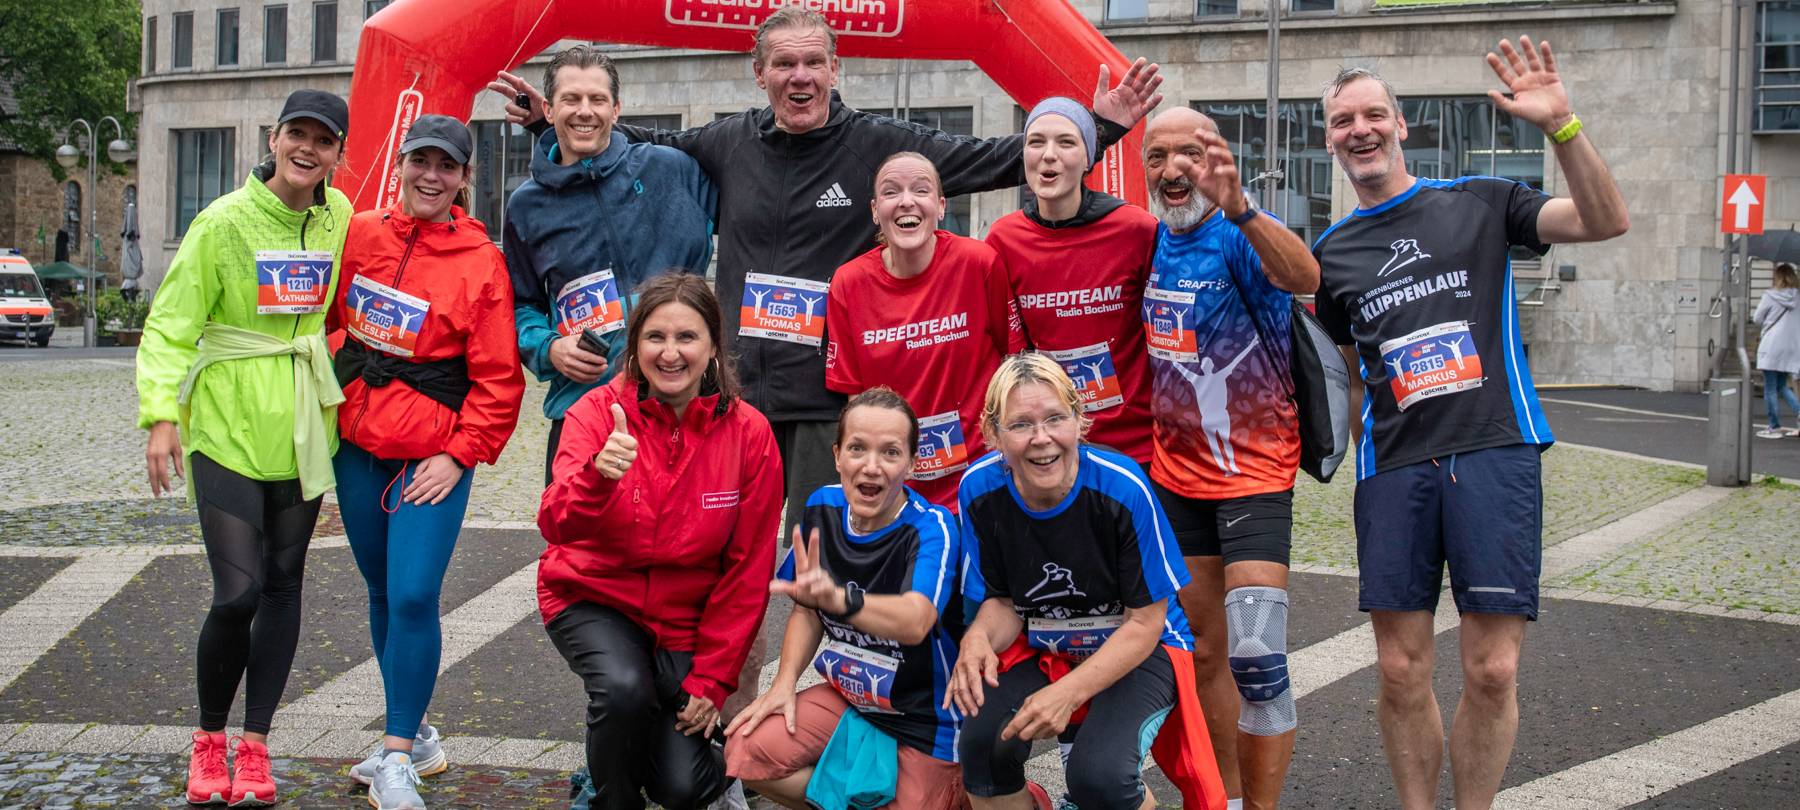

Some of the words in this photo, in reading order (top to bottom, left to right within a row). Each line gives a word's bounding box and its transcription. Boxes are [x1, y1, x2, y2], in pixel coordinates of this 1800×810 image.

[816, 197, 852, 207] adidas
[288, 279, 313, 290] 1210
[1177, 279, 1216, 289] CRAFT
[1365, 275, 1414, 299] IBBENBÜRENER
[278, 294, 319, 302] KATHARINA
[1019, 285, 1122, 309] SPEEDTEAM
[1360, 270, 1468, 323] KLIPPENLAUF
[1455, 290, 1472, 298] 2024
[575, 306, 587, 320] 23
[768, 304, 796, 318] 1563
[1056, 307, 1082, 317] Radio
[1084, 302, 1123, 315] Bochum
[366, 311, 392, 329] 2505
[568, 314, 605, 335] ANDREAS
[759, 317, 801, 332] THOMAS
[863, 312, 967, 345] SPEEDTEAM
[1155, 319, 1172, 335] 1848
[360, 322, 393, 342] LESLEY
[905, 339, 932, 350] Radio
[934, 330, 969, 344] Bochum
[1411, 356, 1444, 375] 2815
[1407, 369, 1457, 391] MARKUS
[839, 677, 864, 696] 2816
